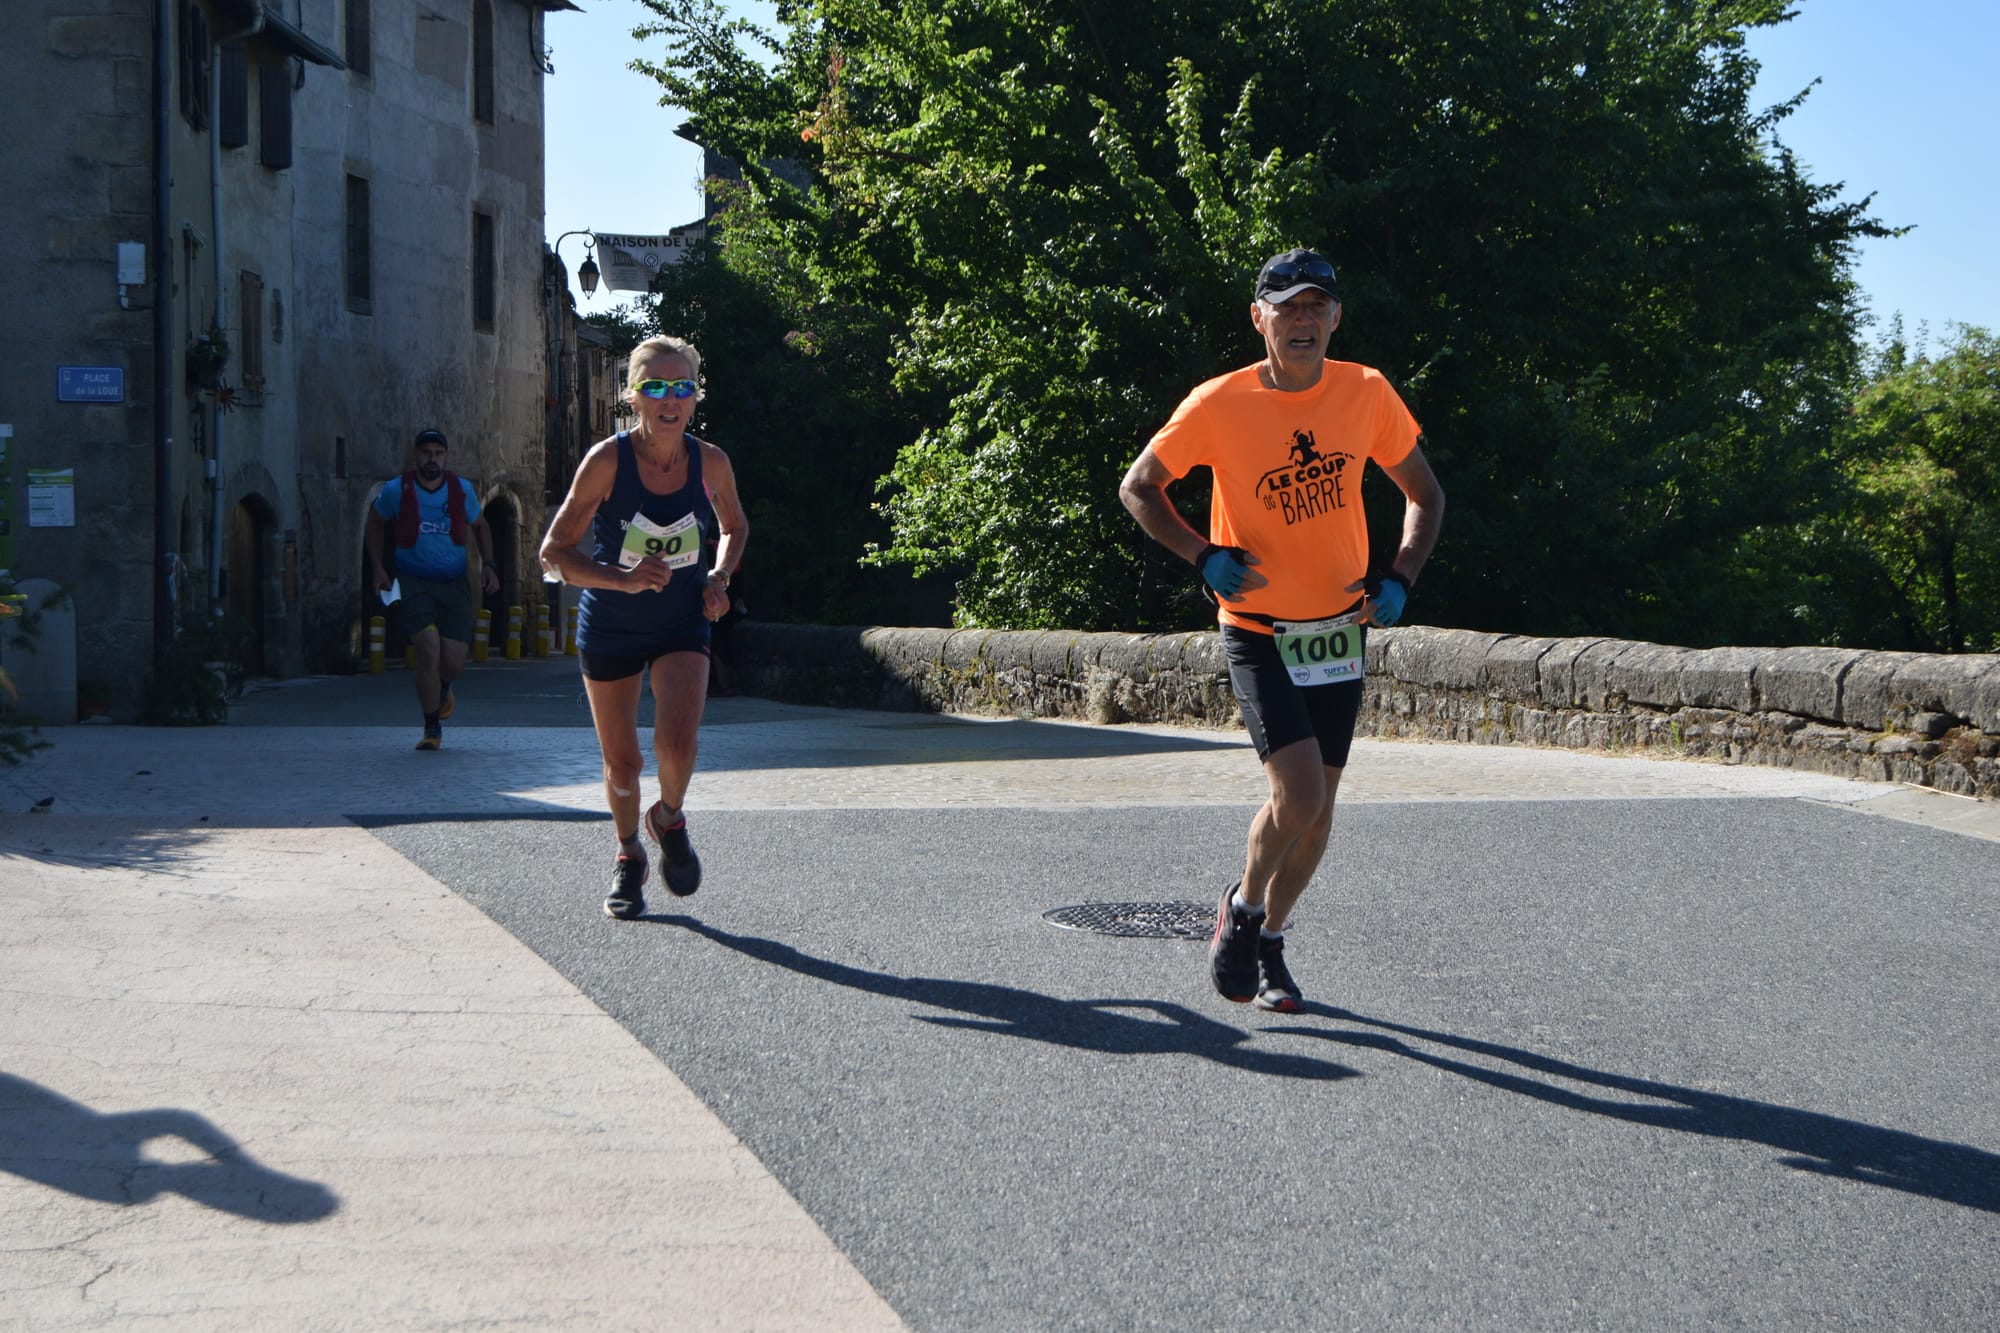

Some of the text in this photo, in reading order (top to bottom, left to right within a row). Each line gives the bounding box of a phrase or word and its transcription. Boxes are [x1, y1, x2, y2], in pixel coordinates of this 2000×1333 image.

[600, 237, 659, 248] MAISON
[663, 237, 681, 248] DE
[83, 373, 110, 383] PLACE
[75, 386, 86, 395] de
[1268, 457, 1346, 492] LE COUP
[1263, 474, 1346, 526] de BARRE
[644, 536, 682, 556] 90
[1288, 631, 1349, 664] 100
